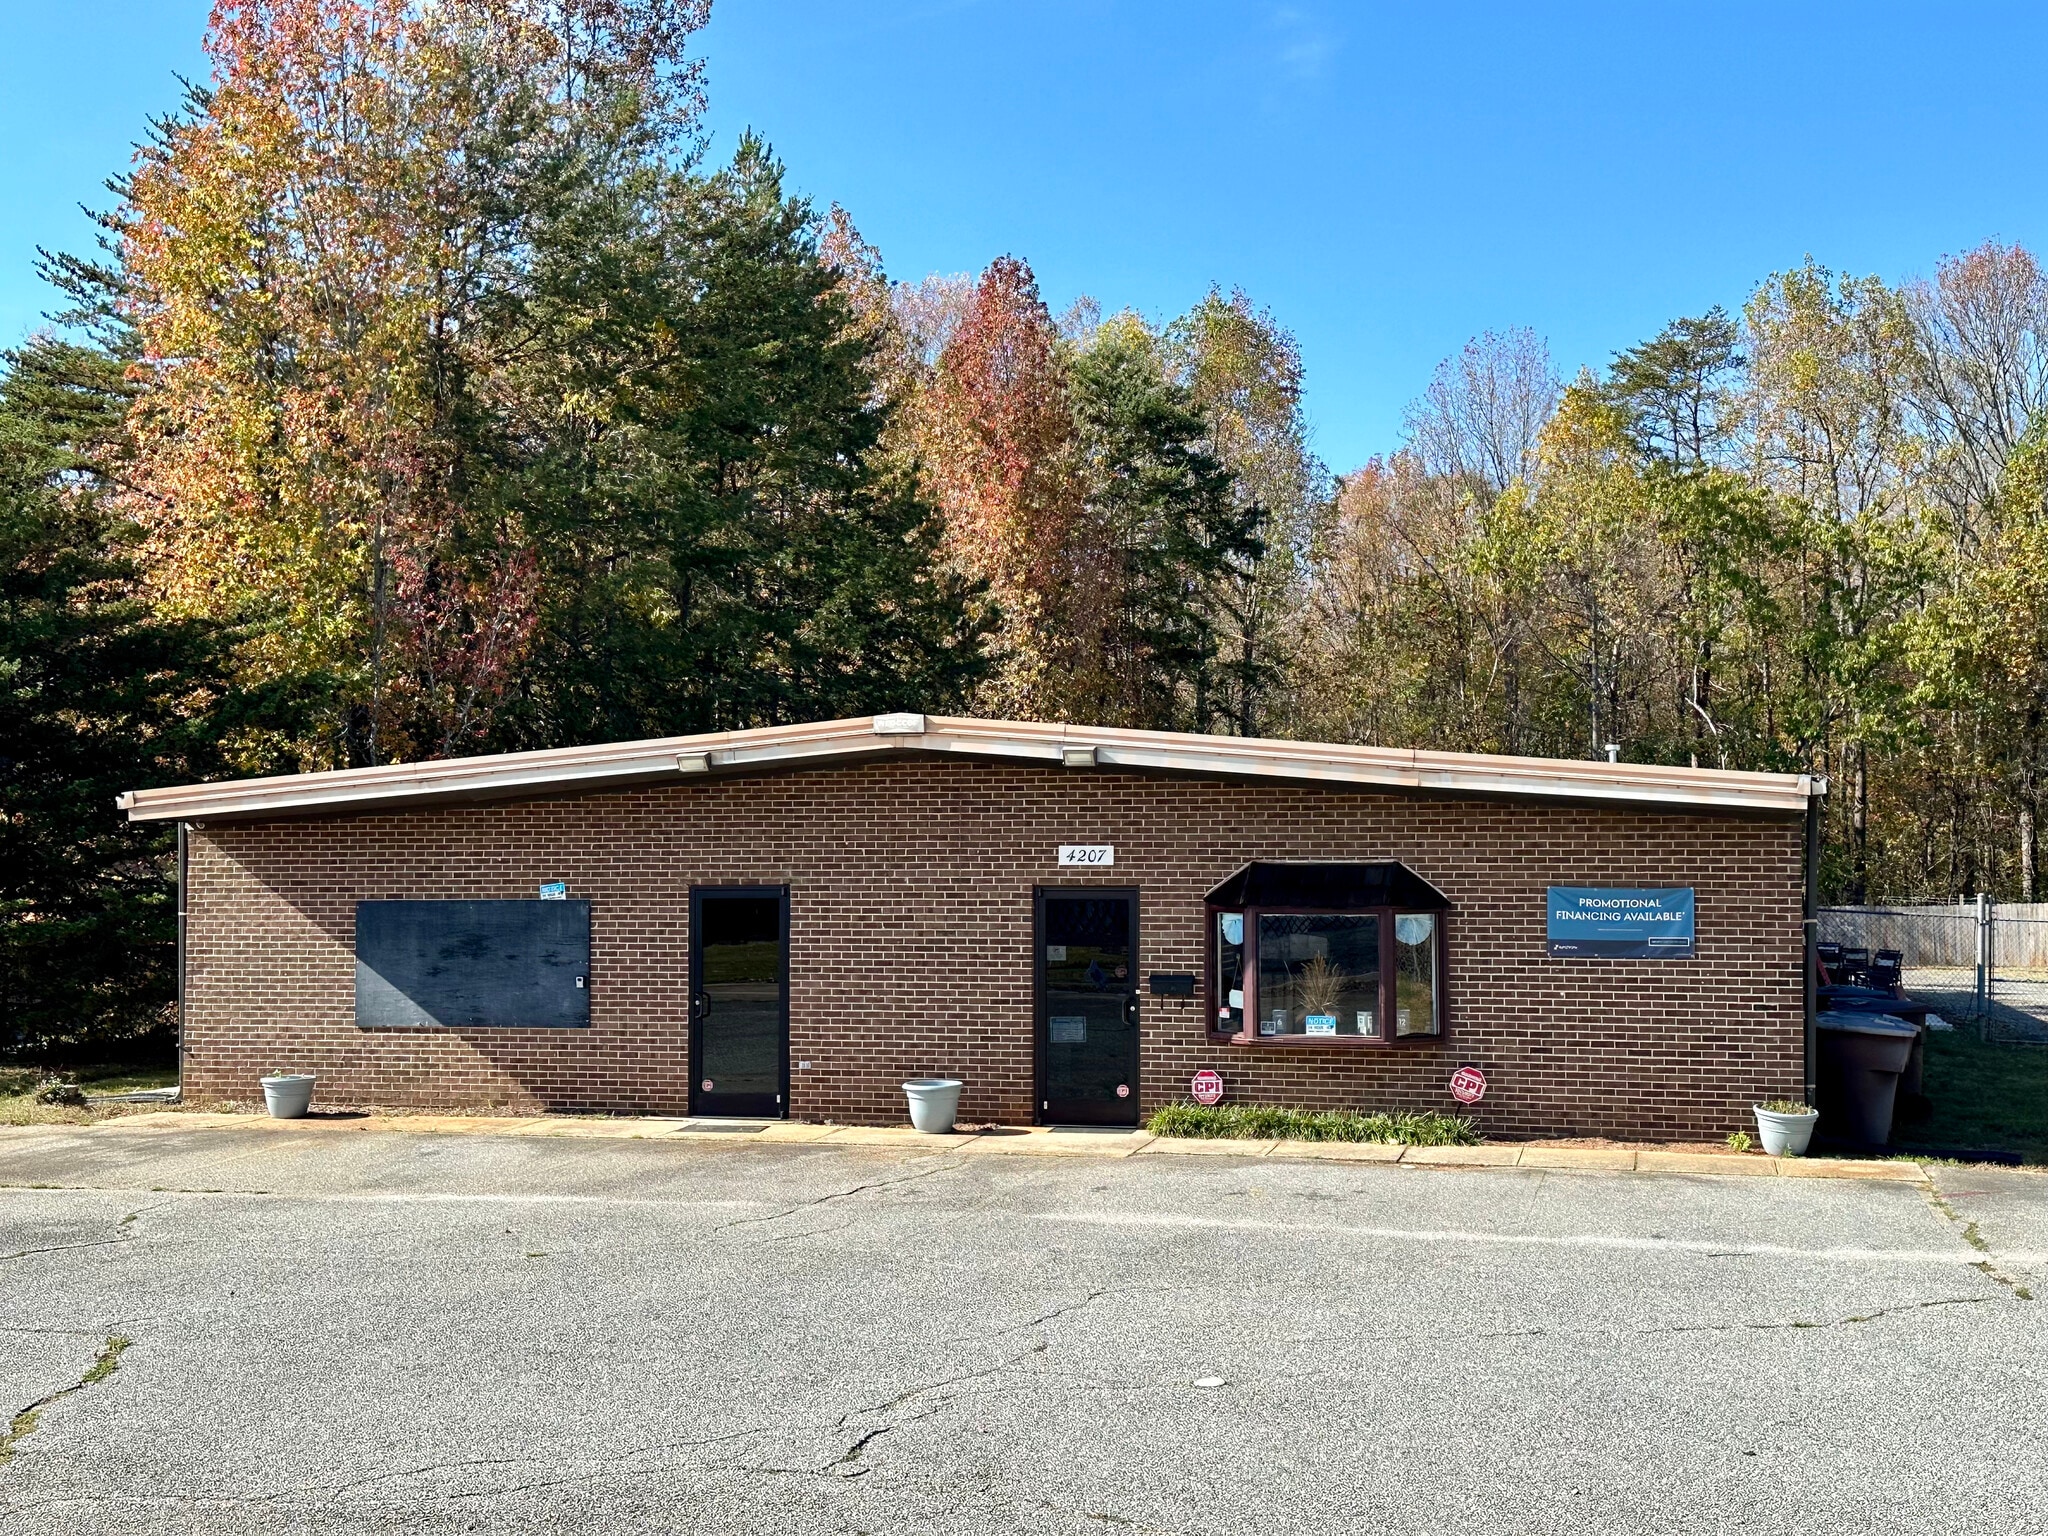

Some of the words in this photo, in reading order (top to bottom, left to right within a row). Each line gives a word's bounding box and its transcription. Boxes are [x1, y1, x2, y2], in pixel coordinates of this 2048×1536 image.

[1066, 849, 1107, 862] 4207
[1579, 898, 1662, 908] PROMOTIONAL
[1556, 911, 1621, 921] FINANCING
[1398, 1018, 1406, 1026] 12
[1194, 1081, 1220, 1093] CPI
[1453, 1075, 1484, 1095] CPI
